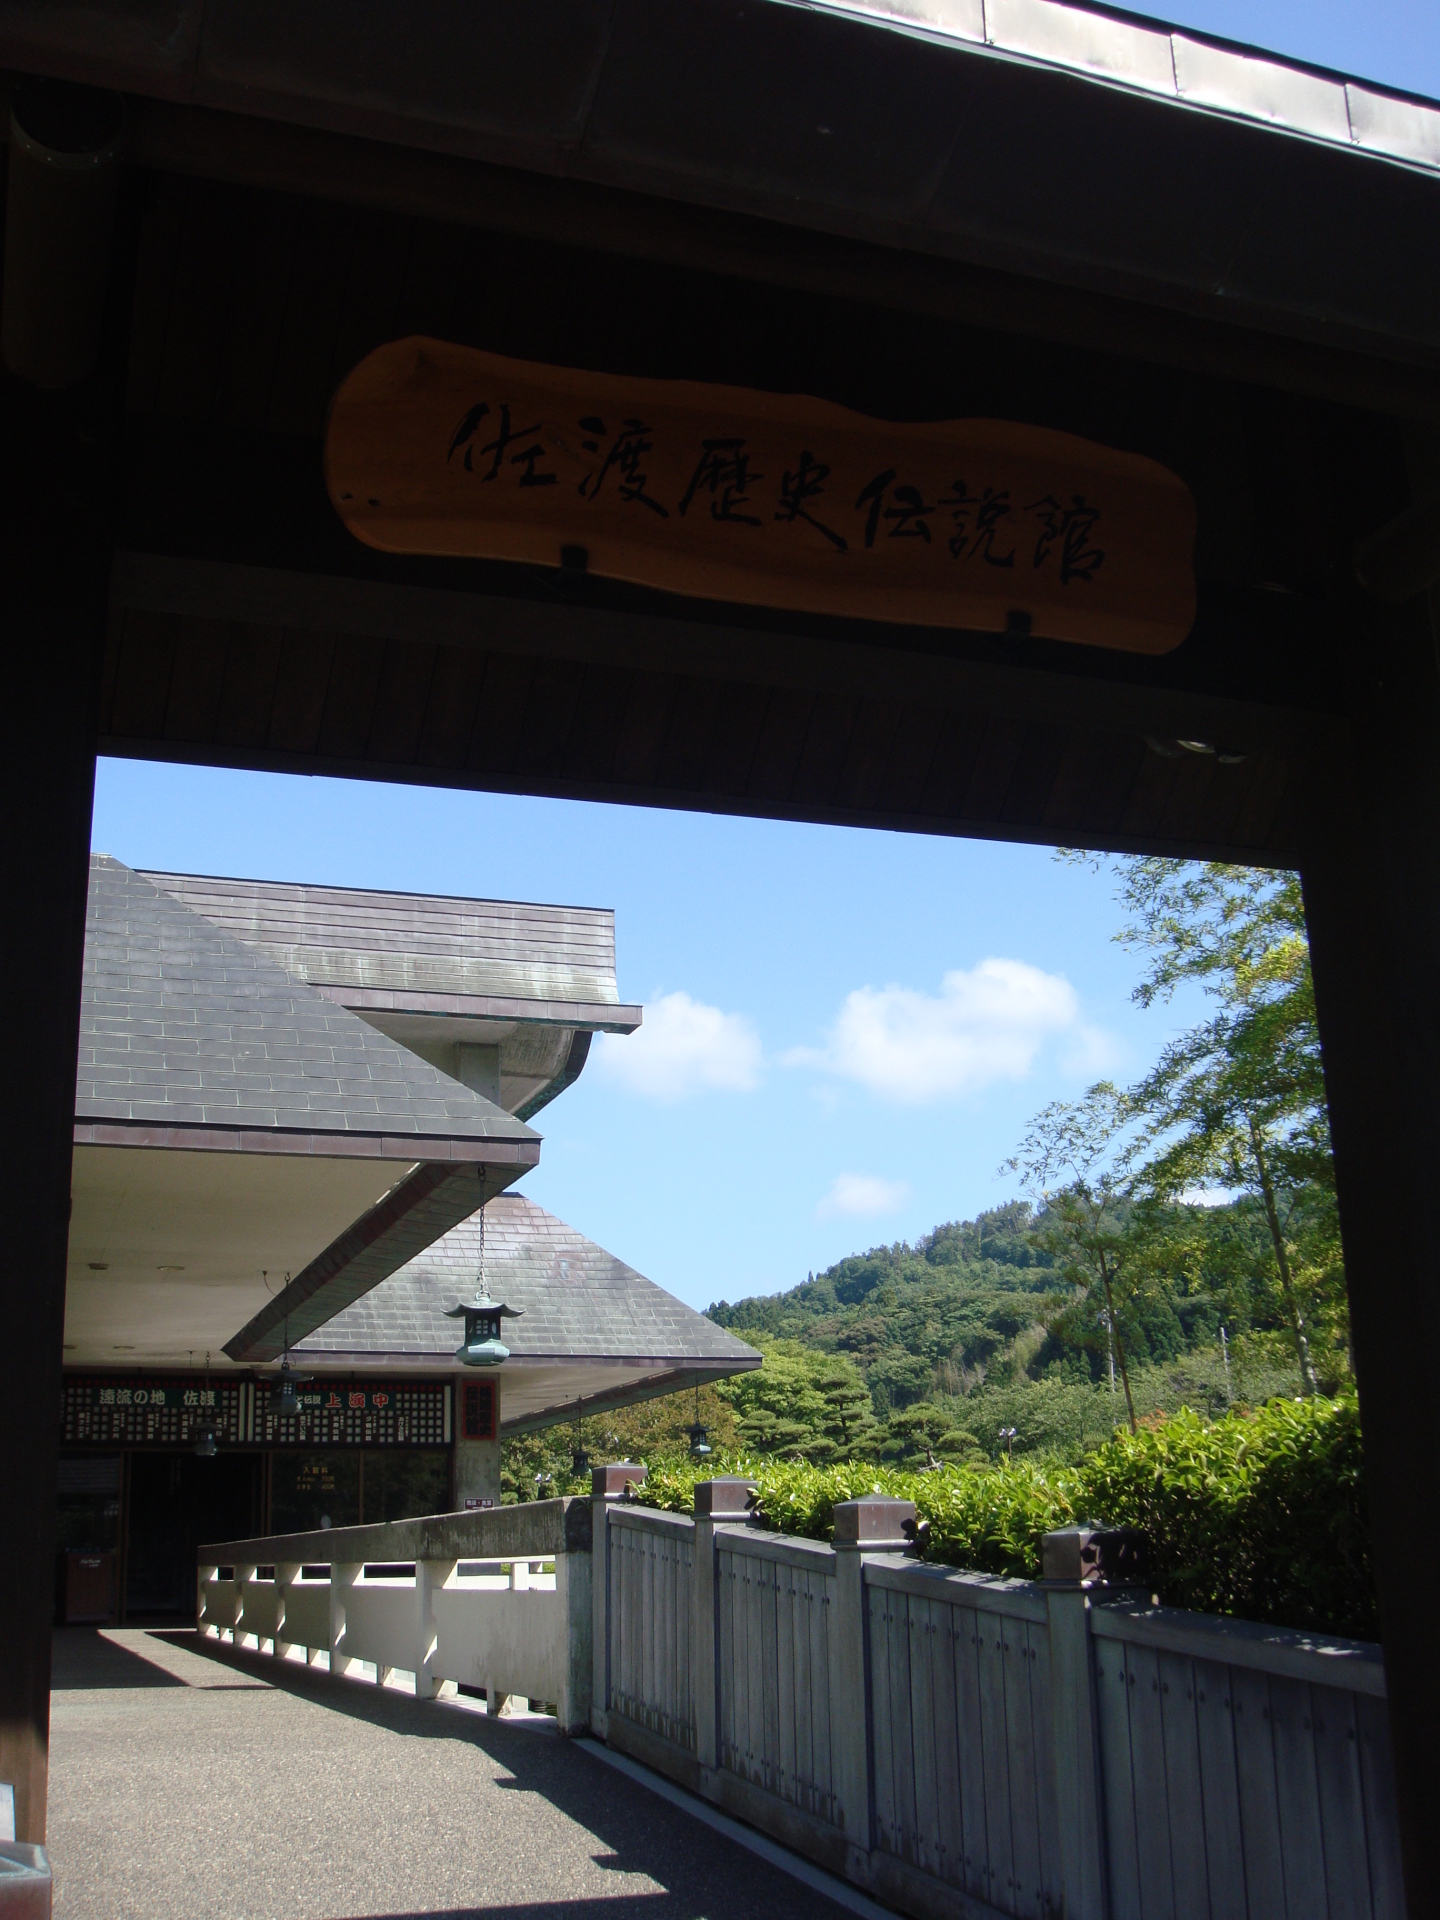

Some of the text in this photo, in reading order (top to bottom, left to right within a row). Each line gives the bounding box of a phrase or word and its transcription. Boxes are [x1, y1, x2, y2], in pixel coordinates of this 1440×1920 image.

[448, 402, 1106, 586] 佐渡歴史伝説館
[325, 1391, 389, 1408] 上演中
